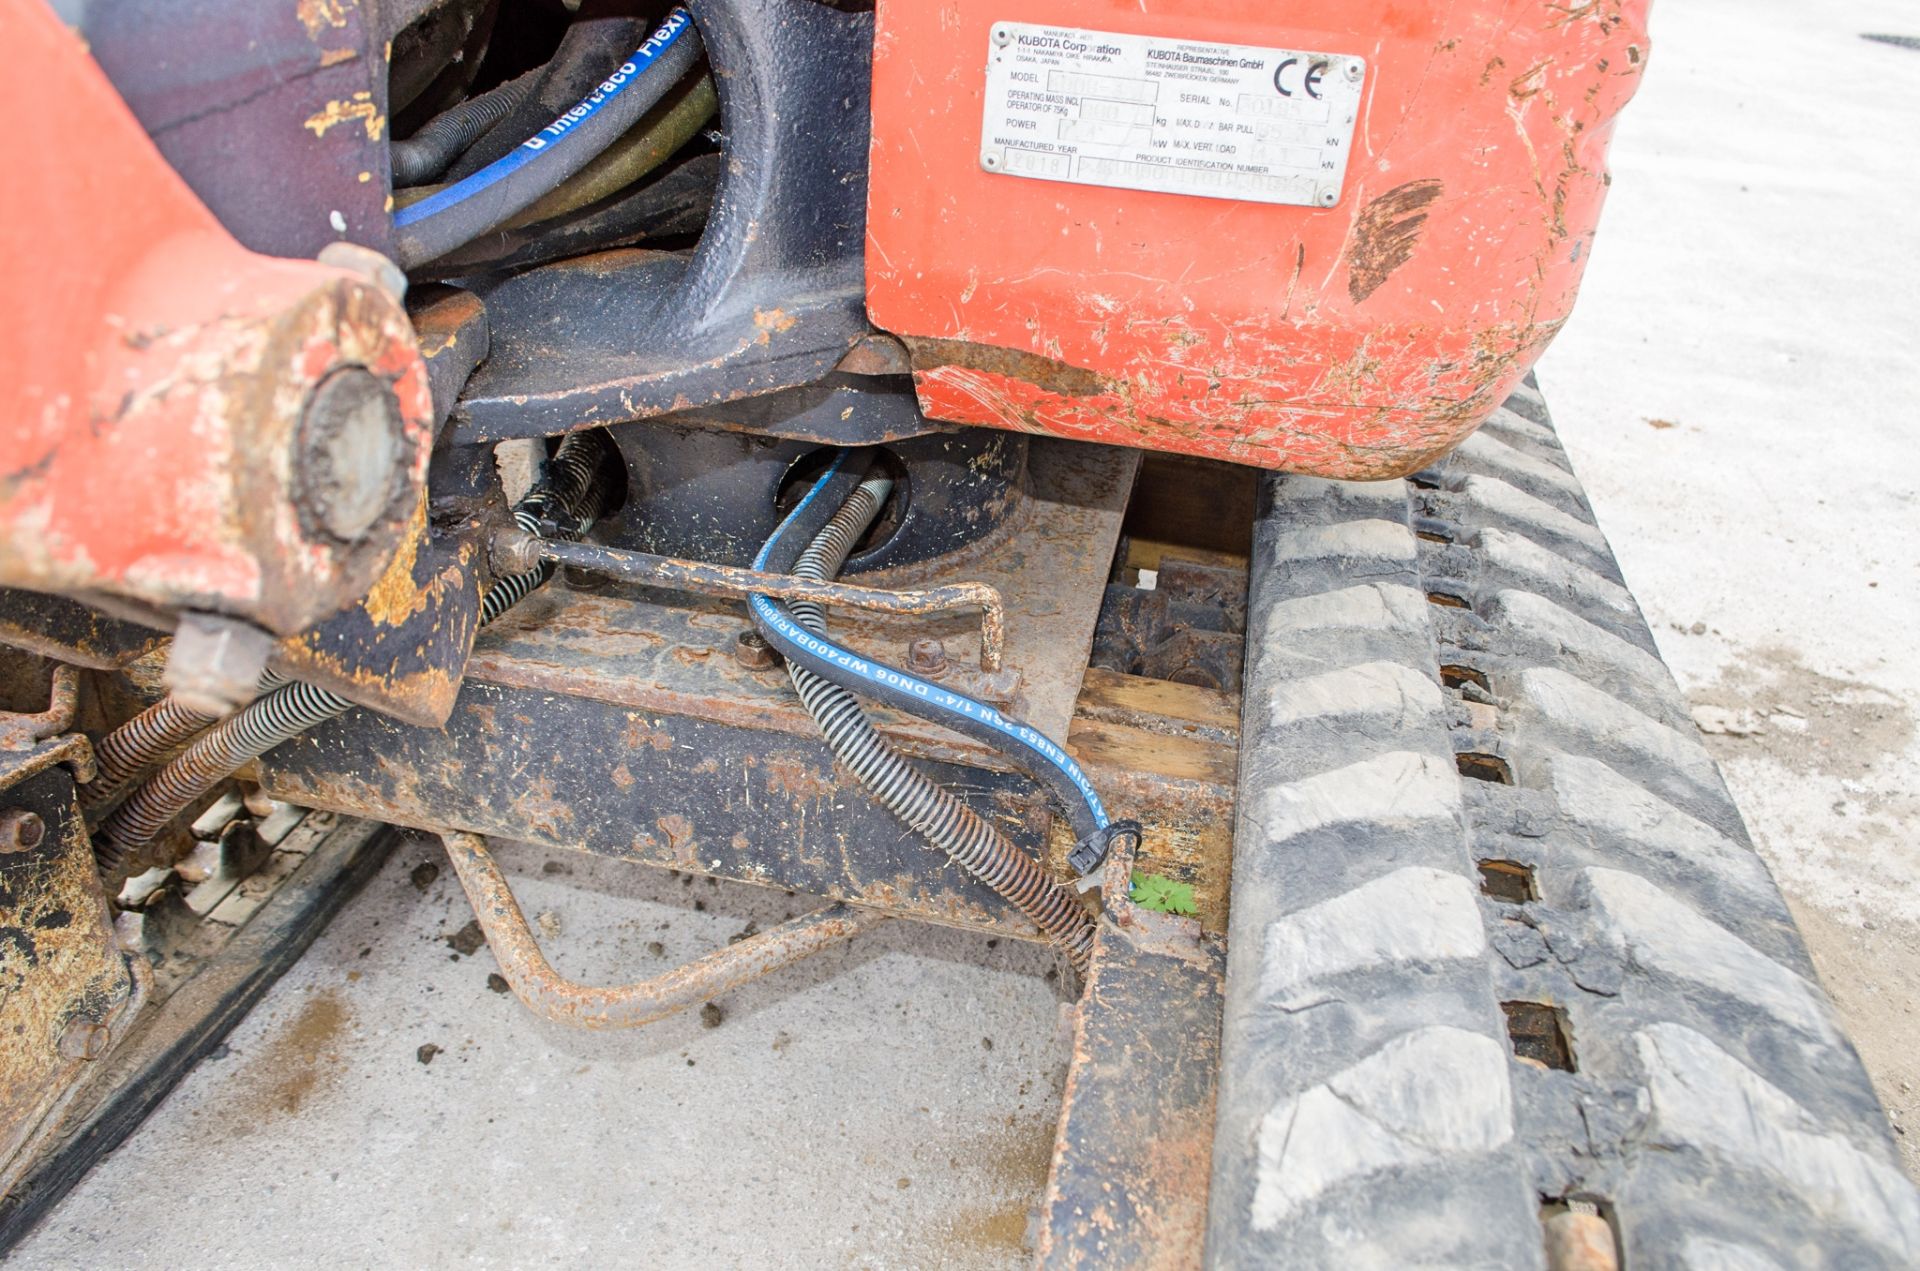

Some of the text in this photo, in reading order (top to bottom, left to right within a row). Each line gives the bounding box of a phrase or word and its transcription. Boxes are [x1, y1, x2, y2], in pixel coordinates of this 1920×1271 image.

[1018, 34, 1121, 55] KUBOTA Corpation
[1040, 58, 1060, 66] JAPAN
[1147, 49, 1264, 70] KUBOTA Baumaschinen GmbH
[1010, 72, 1039, 83] MODEL
[1273, 58, 1328, 100] CE
[1008, 90, 1044, 102] OPERATING
[1046, 94, 1064, 104] MASS
[1180, 94, 1210, 104] SERIAL
[1219, 98, 1232, 106] No.
[1007, 100, 1042, 112] OPERATOR
[1042, 104, 1052, 112] OF
[1006, 118, 1037, 130] POWER
[1156, 116, 1167, 126] kg
[1218, 122, 1233, 132] BAR
[1236, 125, 1254, 134] PULL
[994, 137, 1078, 154] MANUFACTURED YEAR
[1153, 139, 1168, 148] kW
[1326, 138, 1339, 146] kN
[1136, 153, 1268, 174] PRODUCT IDENTIFICATION NUMBER
[1322, 161, 1334, 170] kN
[876, 668, 929, 697] DN06
[1017, 726, 1066, 764] EN853
